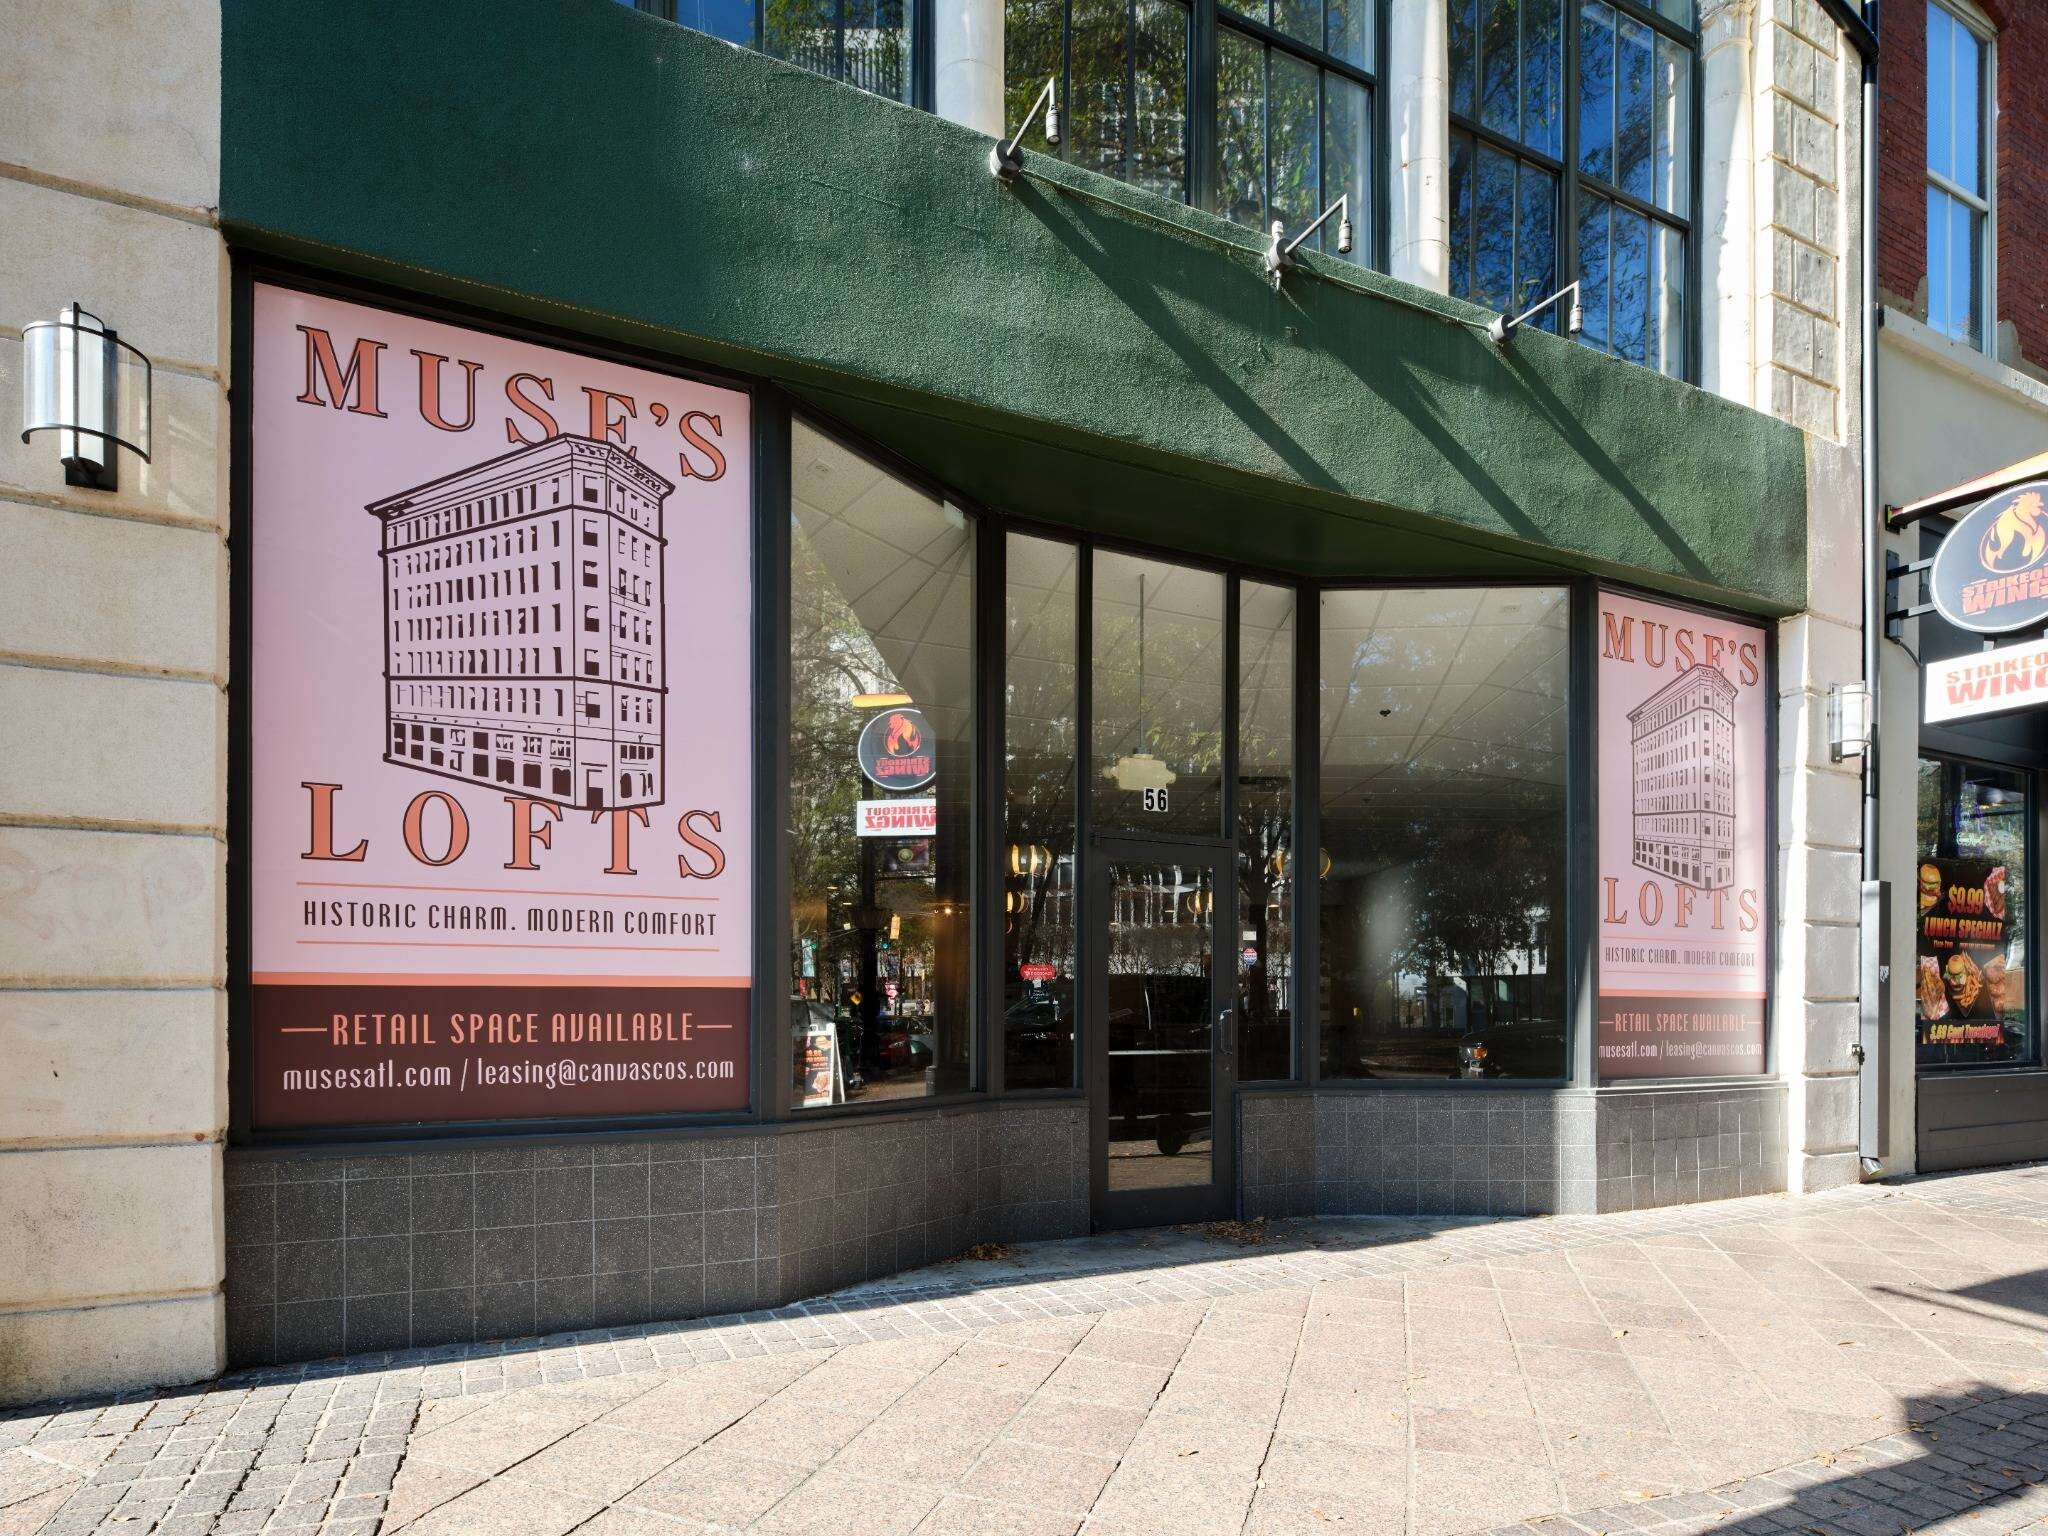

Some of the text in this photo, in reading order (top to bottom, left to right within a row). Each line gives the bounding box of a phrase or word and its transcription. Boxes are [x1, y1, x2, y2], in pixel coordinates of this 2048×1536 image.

[296, 324, 727, 482] MUSE'S
[1602, 611, 1759, 687] MUSE'S
[1145, 788, 1167, 811] 56
[301, 782, 726, 880] LOFTS
[1604, 877, 1759, 931] LOFTS
[1948, 884, 1984, 914] $9.99
[304, 900, 718, 937] HISTORIC CHARM. MODERN COMFORT
[1924, 916, 1957, 938] LUNCH
[1605, 946, 1755, 967] HISTORIC CHARM. MODERN COMFORT
[332, 1012, 694, 1046] RETAIL SPACE AVAILABLE
[1615, 1013, 1746, 1032] RETAIL SPACE AVAILABLE
[1599, 1040, 1658, 1058] musesatl.com
[283, 1058, 735, 1092] musesatl.com / leasing@canvascos.com
